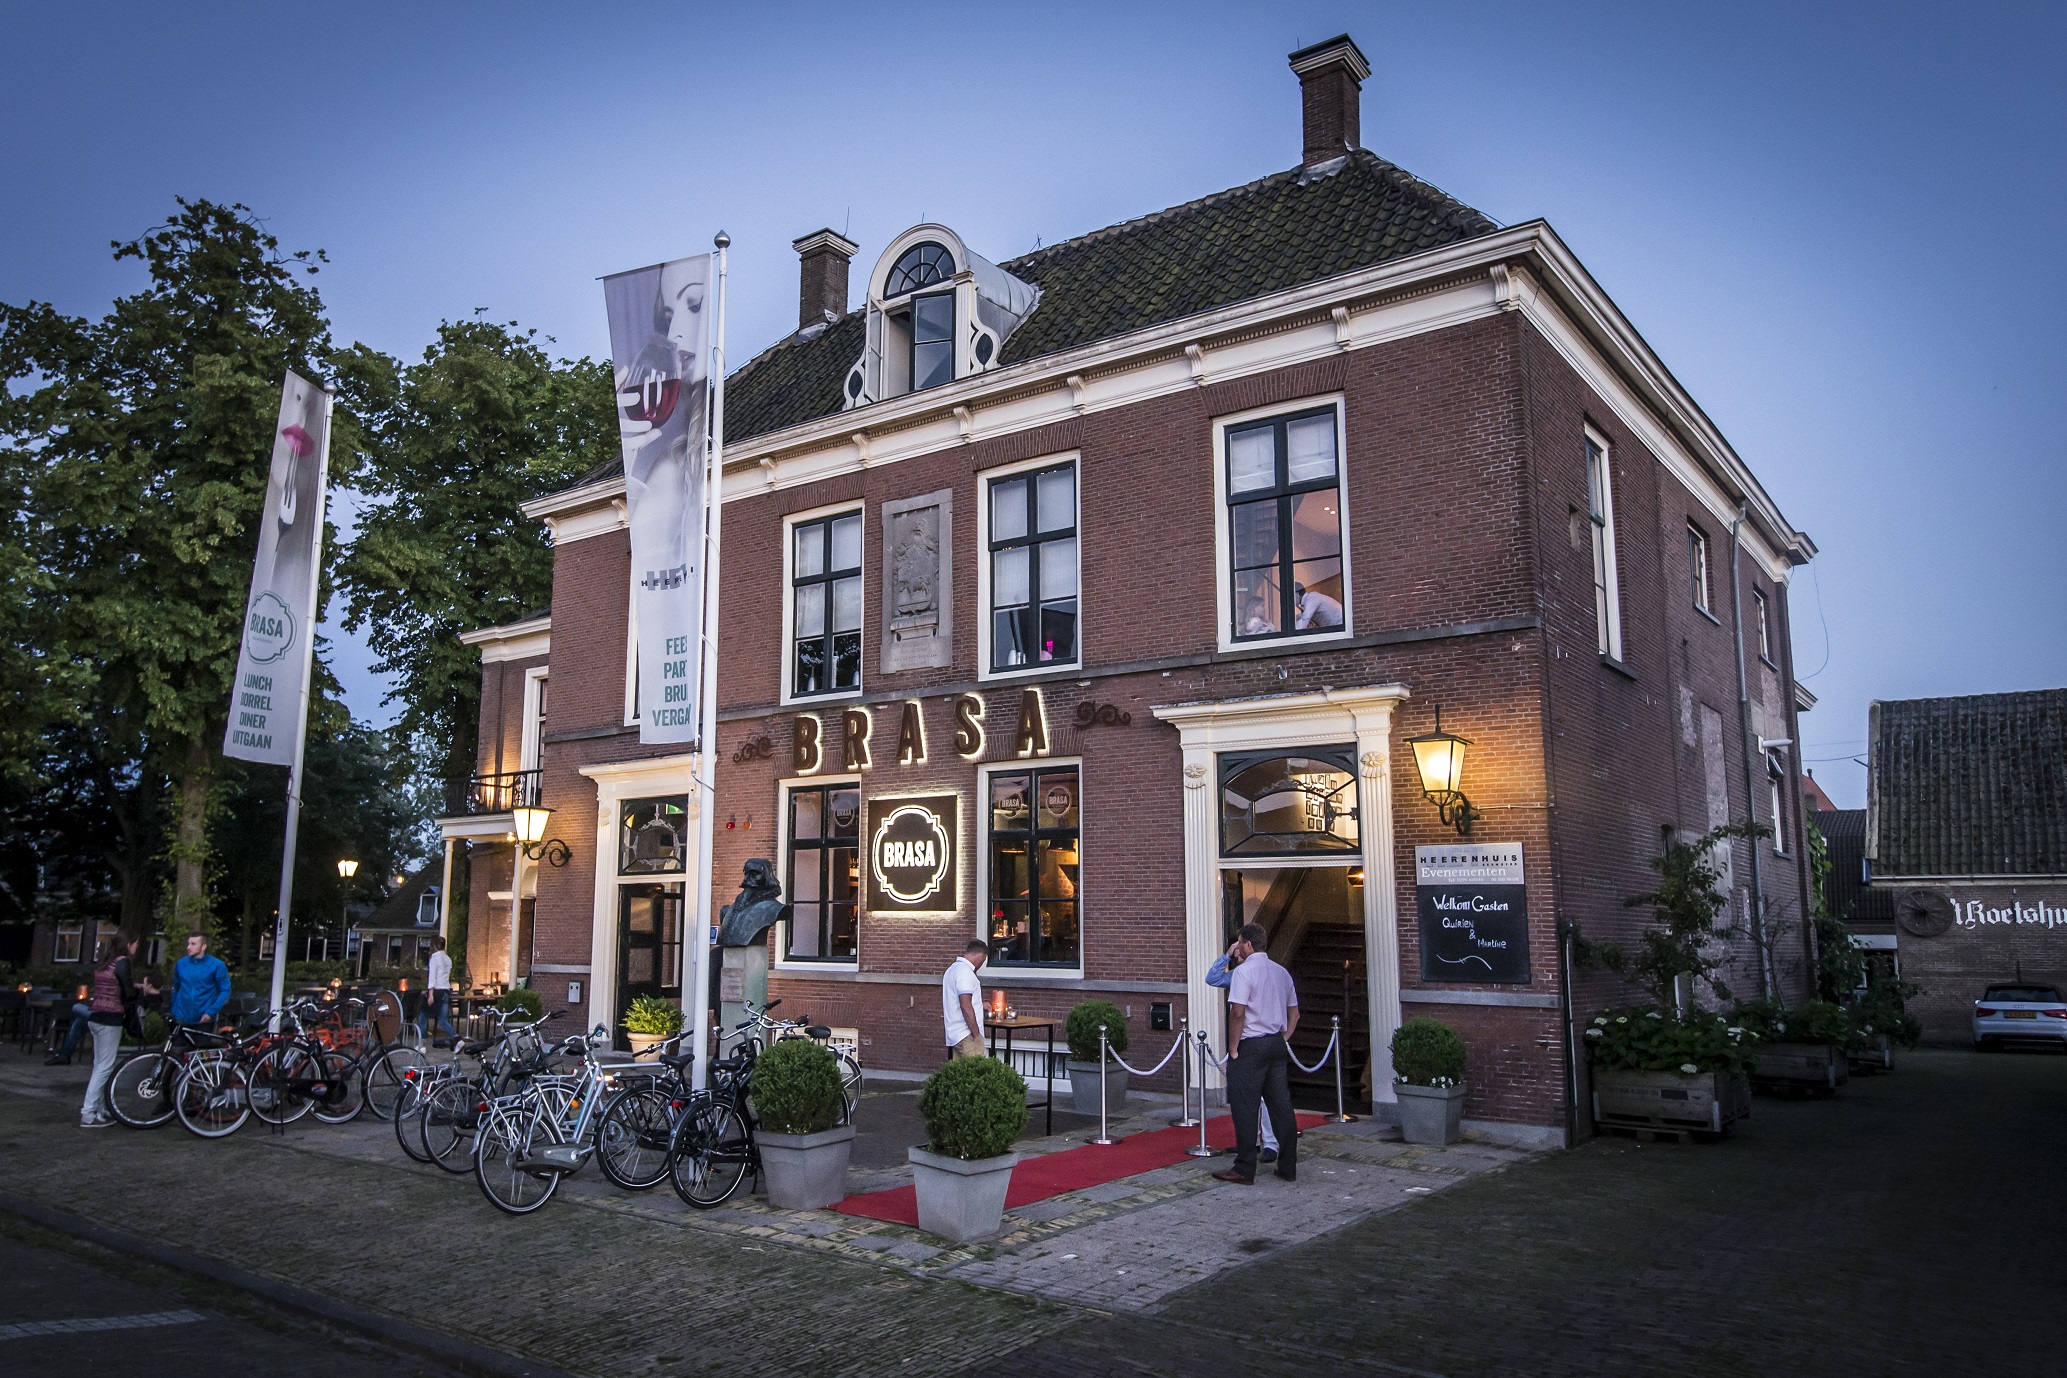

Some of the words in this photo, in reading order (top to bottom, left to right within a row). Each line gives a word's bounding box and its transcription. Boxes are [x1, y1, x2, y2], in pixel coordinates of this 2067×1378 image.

[250, 613, 283, 638] BRASA
[663, 660, 687, 679] PAR
[243, 672, 273, 692] LUNCH
[664, 683, 688, 703] BRU
[239, 711, 267, 730] DINER
[232, 729, 273, 750] UITGAAN
[793, 688, 1049, 774] BRASA
[1049, 796, 1068, 805] BRASA
[883, 840, 936, 868] BRASA
[1420, 854, 1518, 864] HEERENHUIS
[1421, 867, 1507, 878] Evenementen
[1432, 894, 1471, 911] Welkom
[1471, 895, 1509, 912] Gasten
[1469, 929, 1476, 940] &
